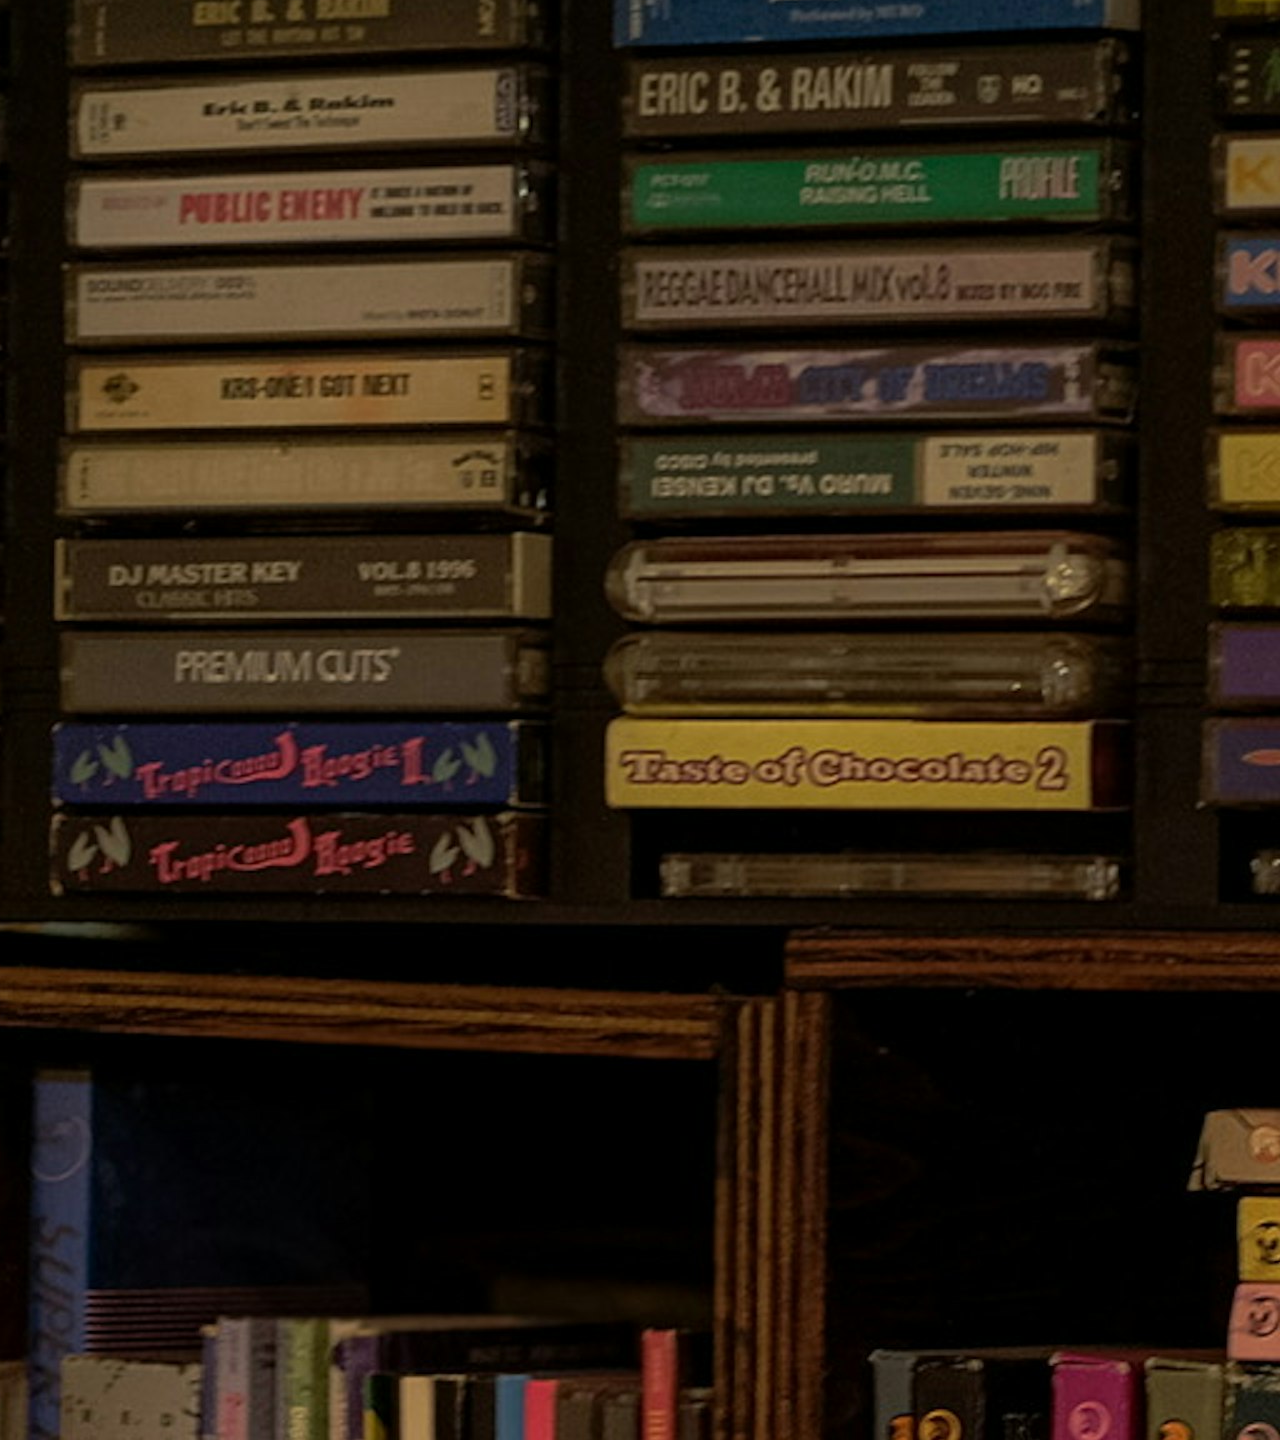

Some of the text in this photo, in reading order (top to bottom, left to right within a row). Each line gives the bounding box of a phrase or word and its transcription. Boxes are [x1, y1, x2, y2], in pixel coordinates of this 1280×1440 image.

[638, 63, 895, 118] ERIC B. & RAKIM
[179, 185, 366, 225] PUBLIC ENEMY
[174, 650, 313, 683] PREMIUM
[299, 743, 401, 790] Boogie
[621, 744, 1069, 791] Taste of Chocolate 2
[312, 828, 416, 878] Boogie
